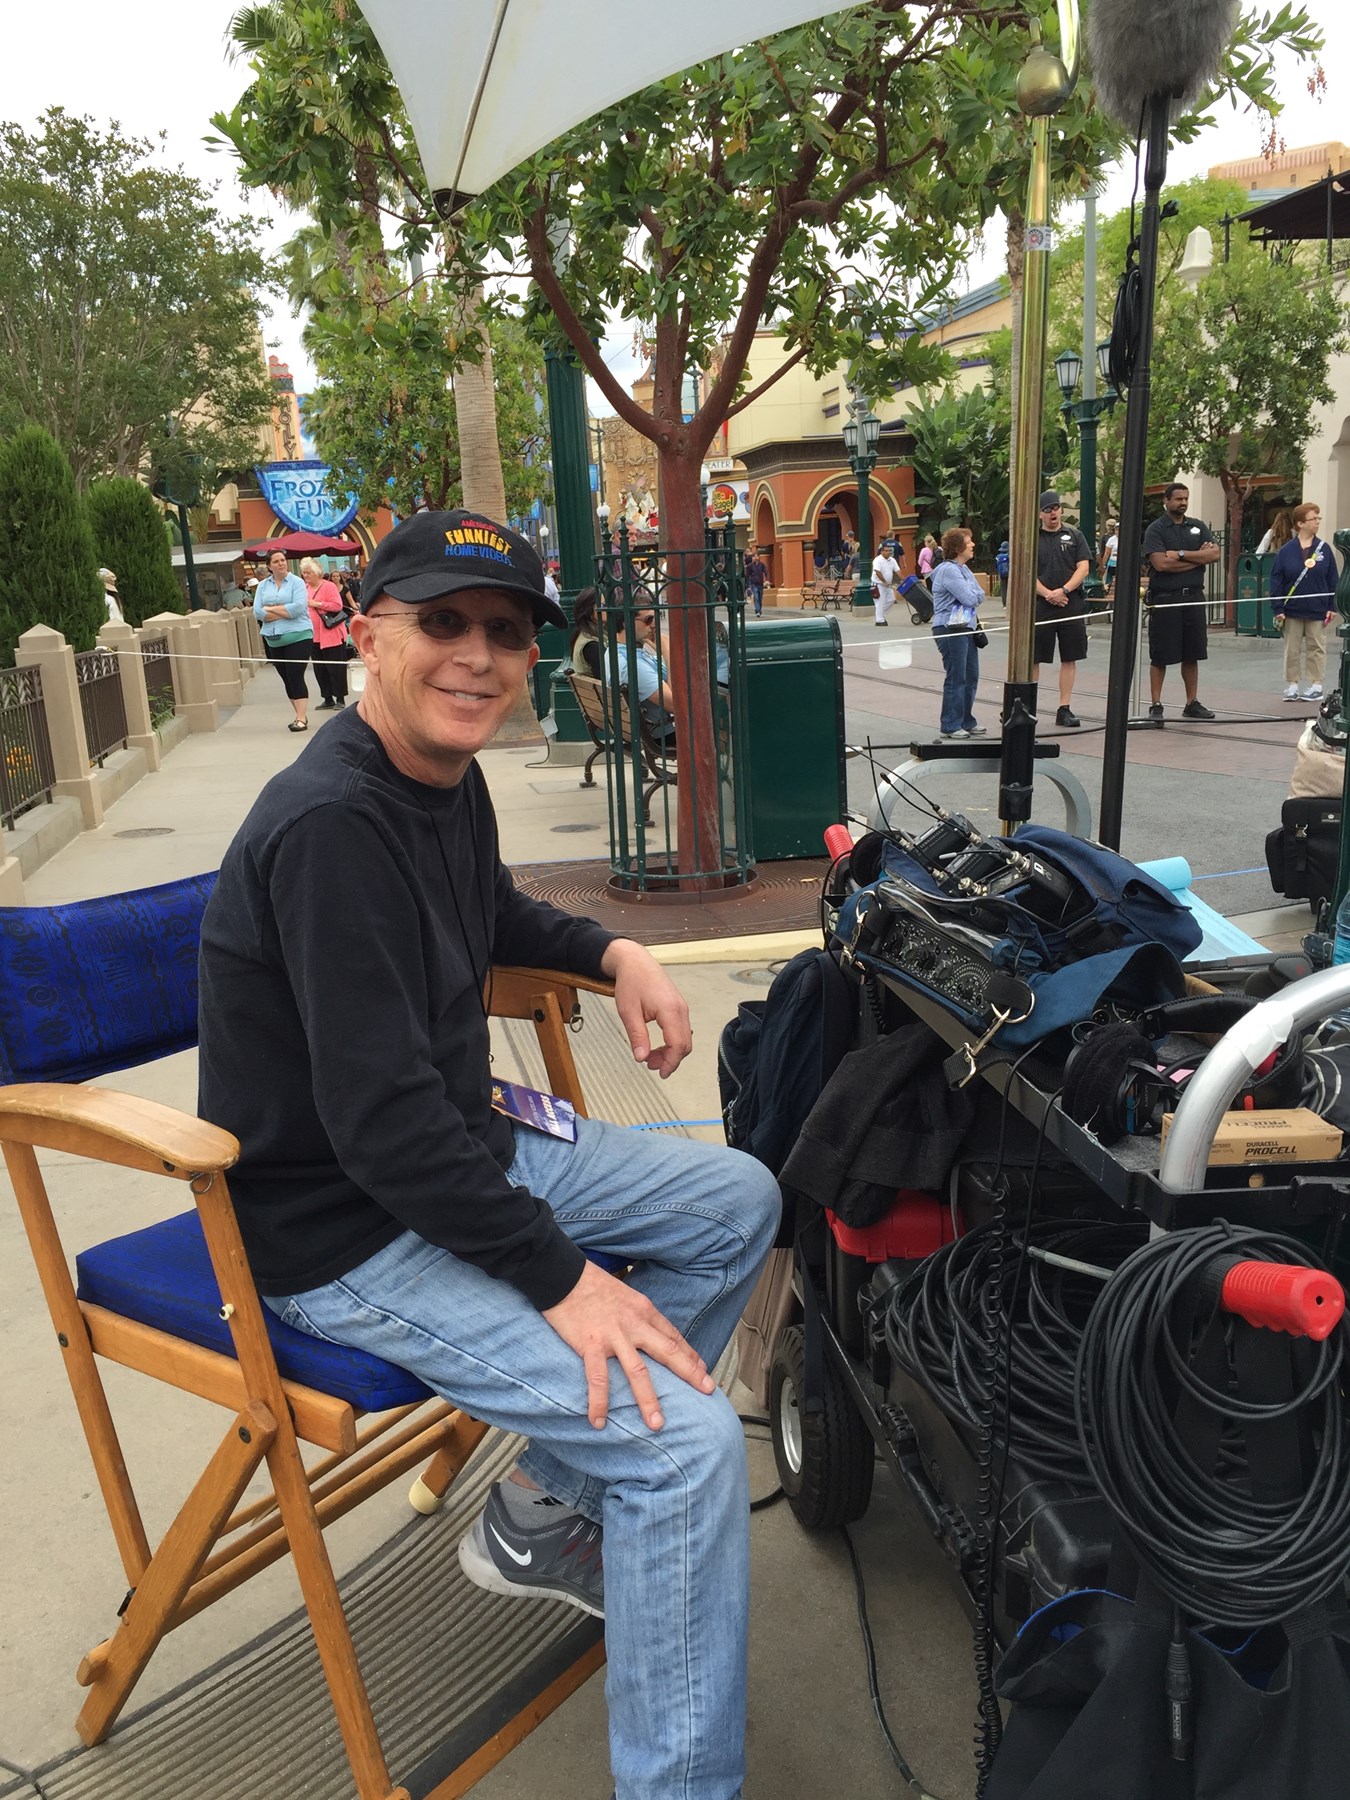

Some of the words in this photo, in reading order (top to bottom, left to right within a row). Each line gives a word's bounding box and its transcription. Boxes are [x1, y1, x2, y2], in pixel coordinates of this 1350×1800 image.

[270, 480, 334, 501] FROZ
[445, 528, 512, 556] FUNNIEST
[445, 544, 479, 556] HOME
[1246, 1140, 1279, 1148] DURACELL
[1244, 1145, 1297, 1156] PROCELL
